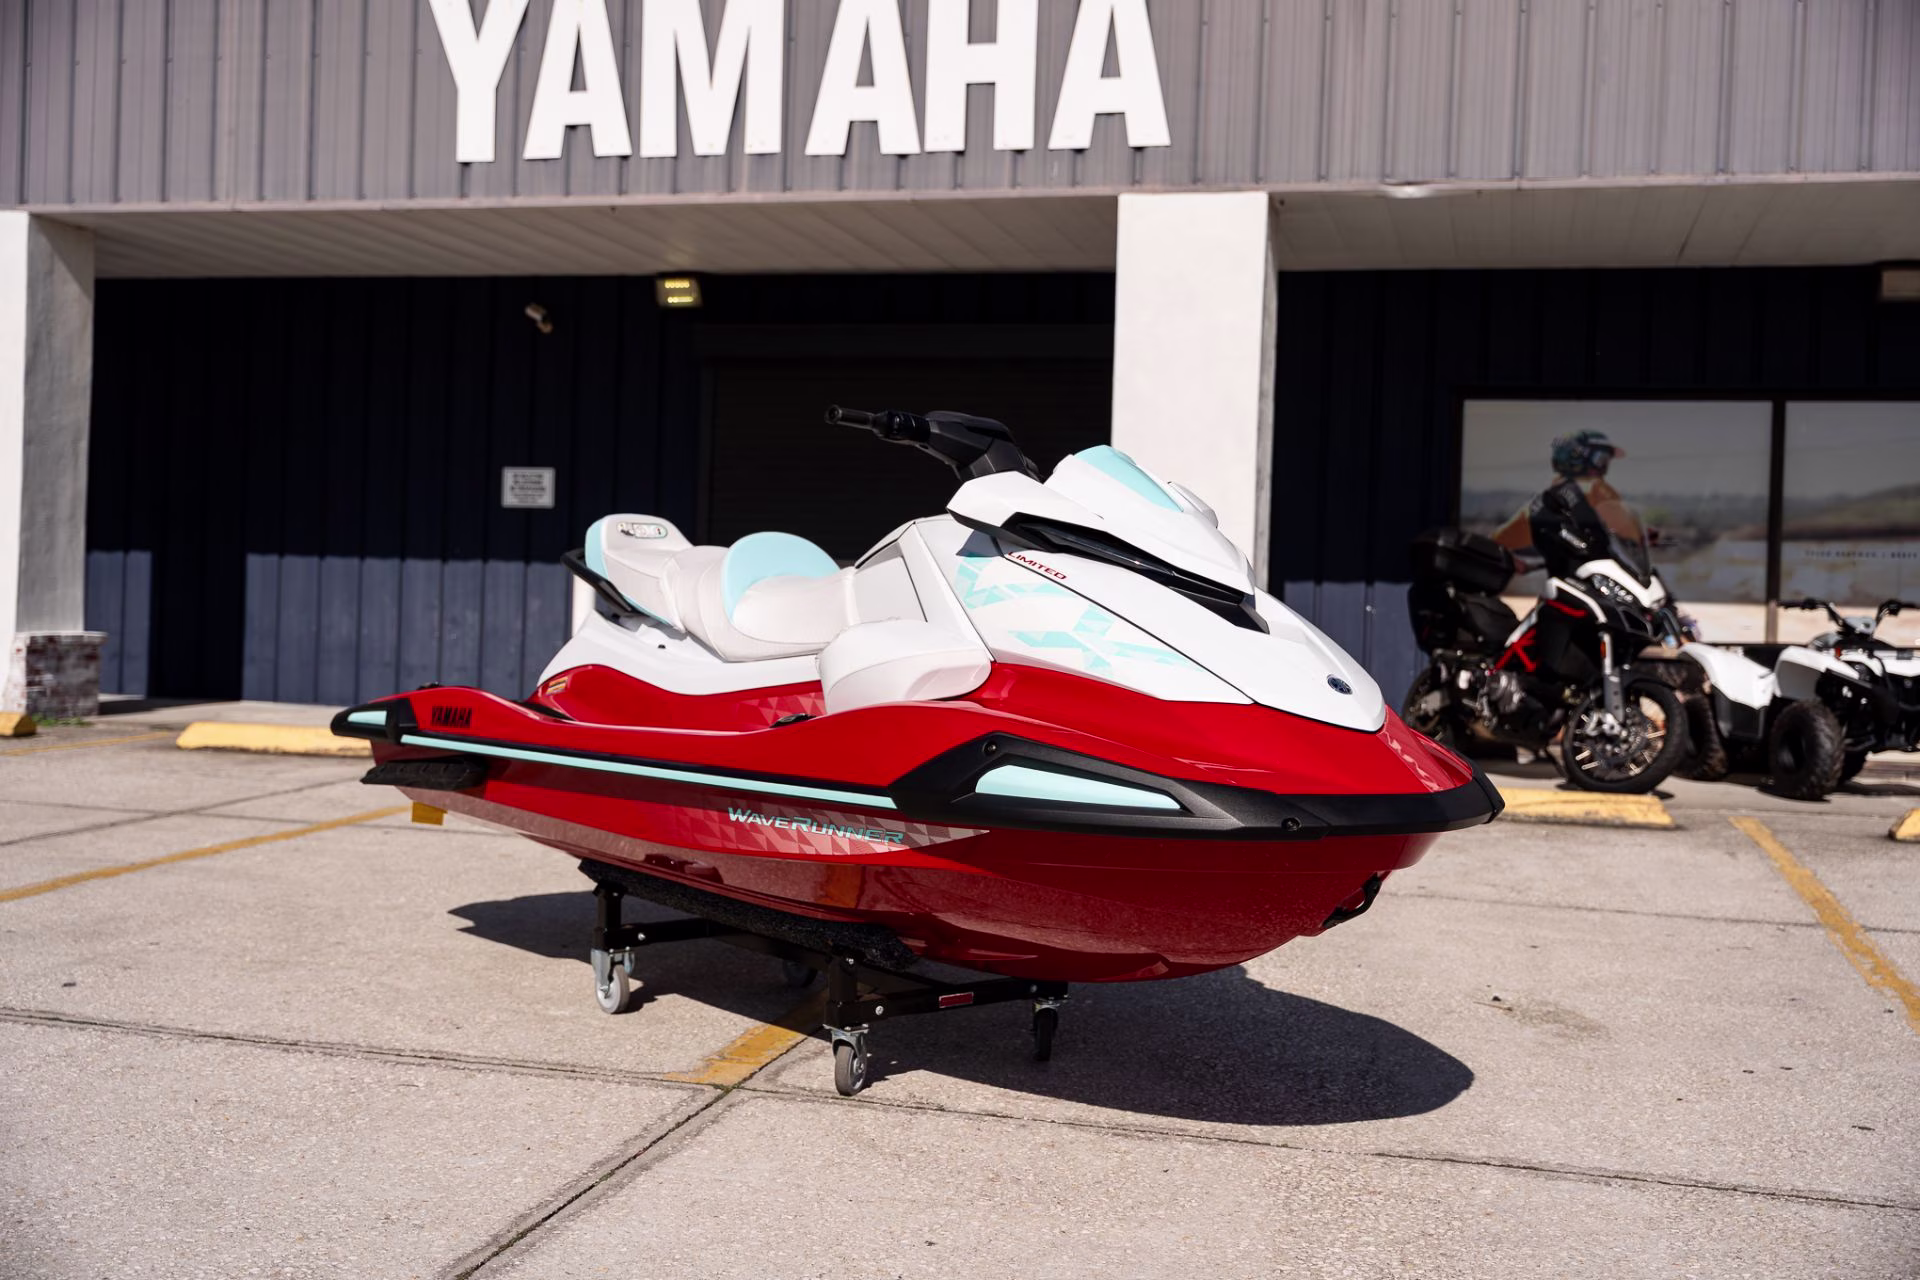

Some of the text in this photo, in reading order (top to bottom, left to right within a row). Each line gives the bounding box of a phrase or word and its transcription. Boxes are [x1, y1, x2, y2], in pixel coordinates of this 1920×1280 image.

[428, 0, 1172, 163] YAMAHA
[1007, 551, 1068, 580] LIMITED
[431, 705, 473, 728] YAMAHA
[727, 807, 905, 843] WAVERUNNER
